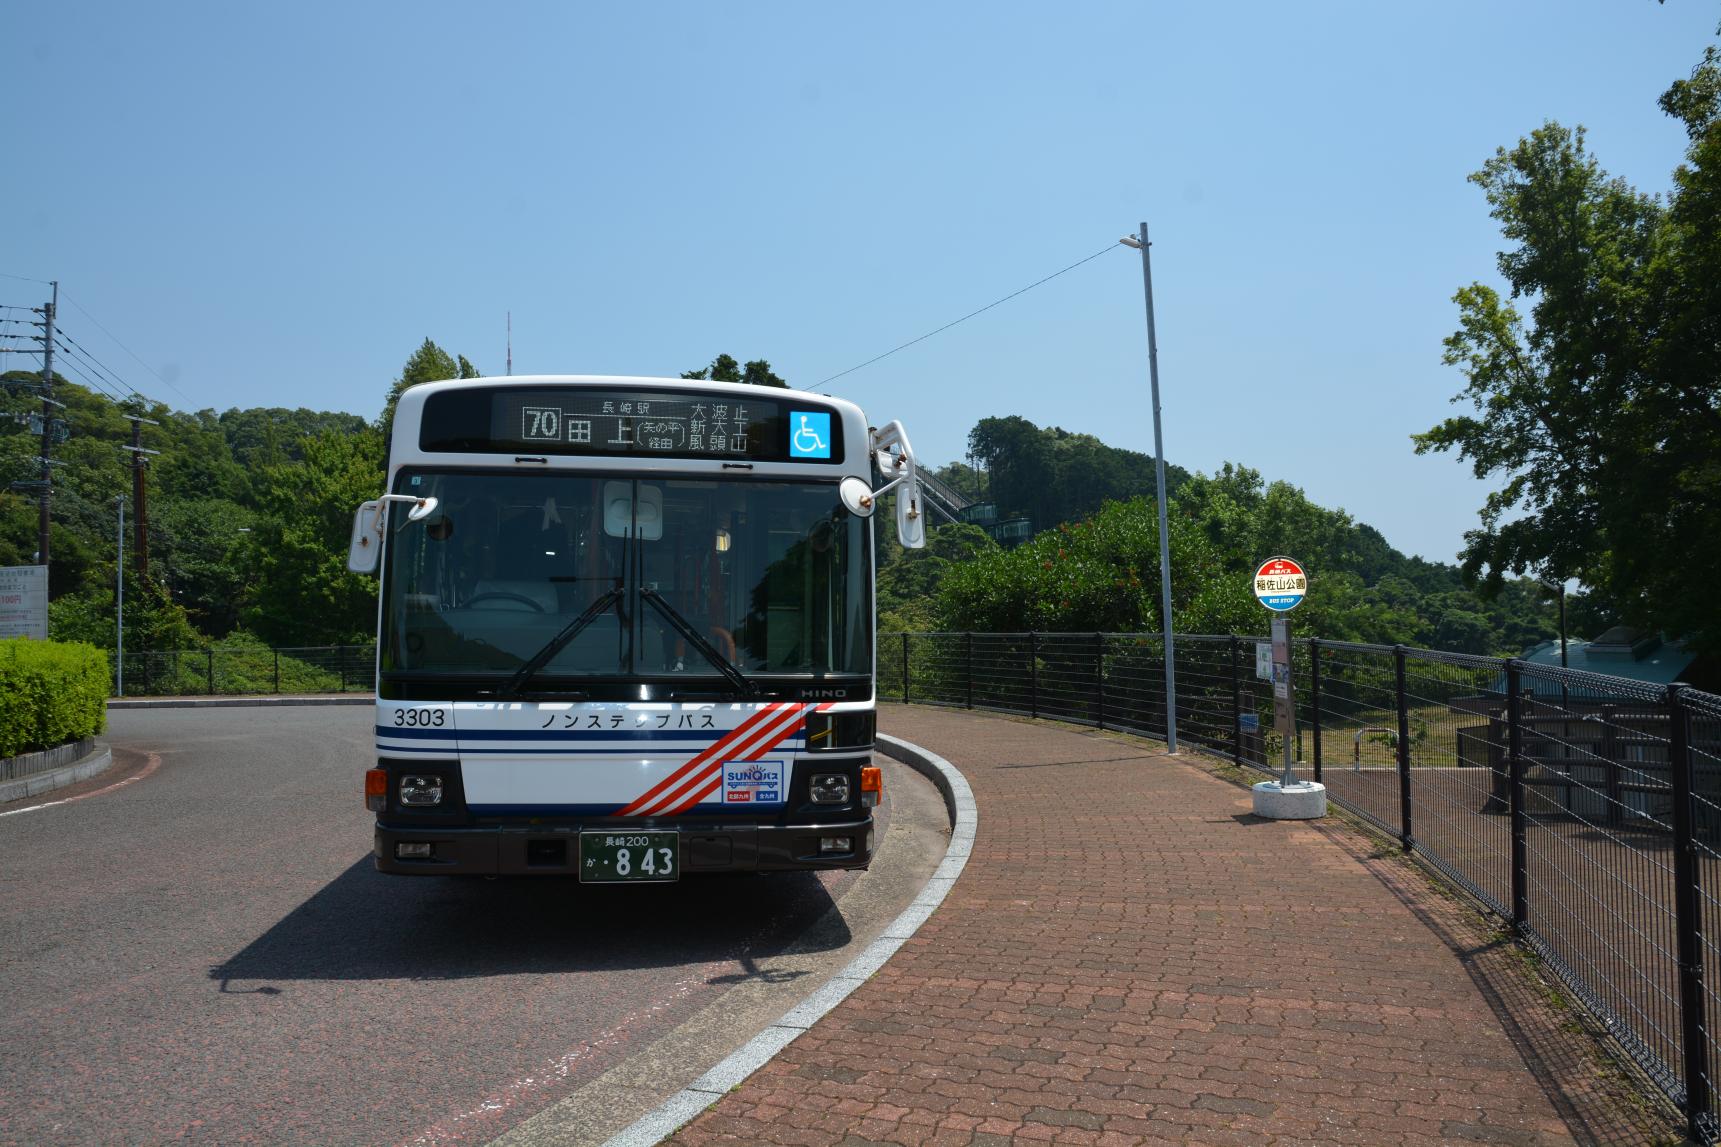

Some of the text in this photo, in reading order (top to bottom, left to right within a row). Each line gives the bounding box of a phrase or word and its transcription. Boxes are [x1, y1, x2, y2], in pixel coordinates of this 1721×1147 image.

[602, 401, 650, 414] 長崎駅
[690, 403, 748, 420] 大波止
[526, 410, 558, 437] 70
[801, 689, 847, 698] HINO
[393, 708, 445, 727] 3303
